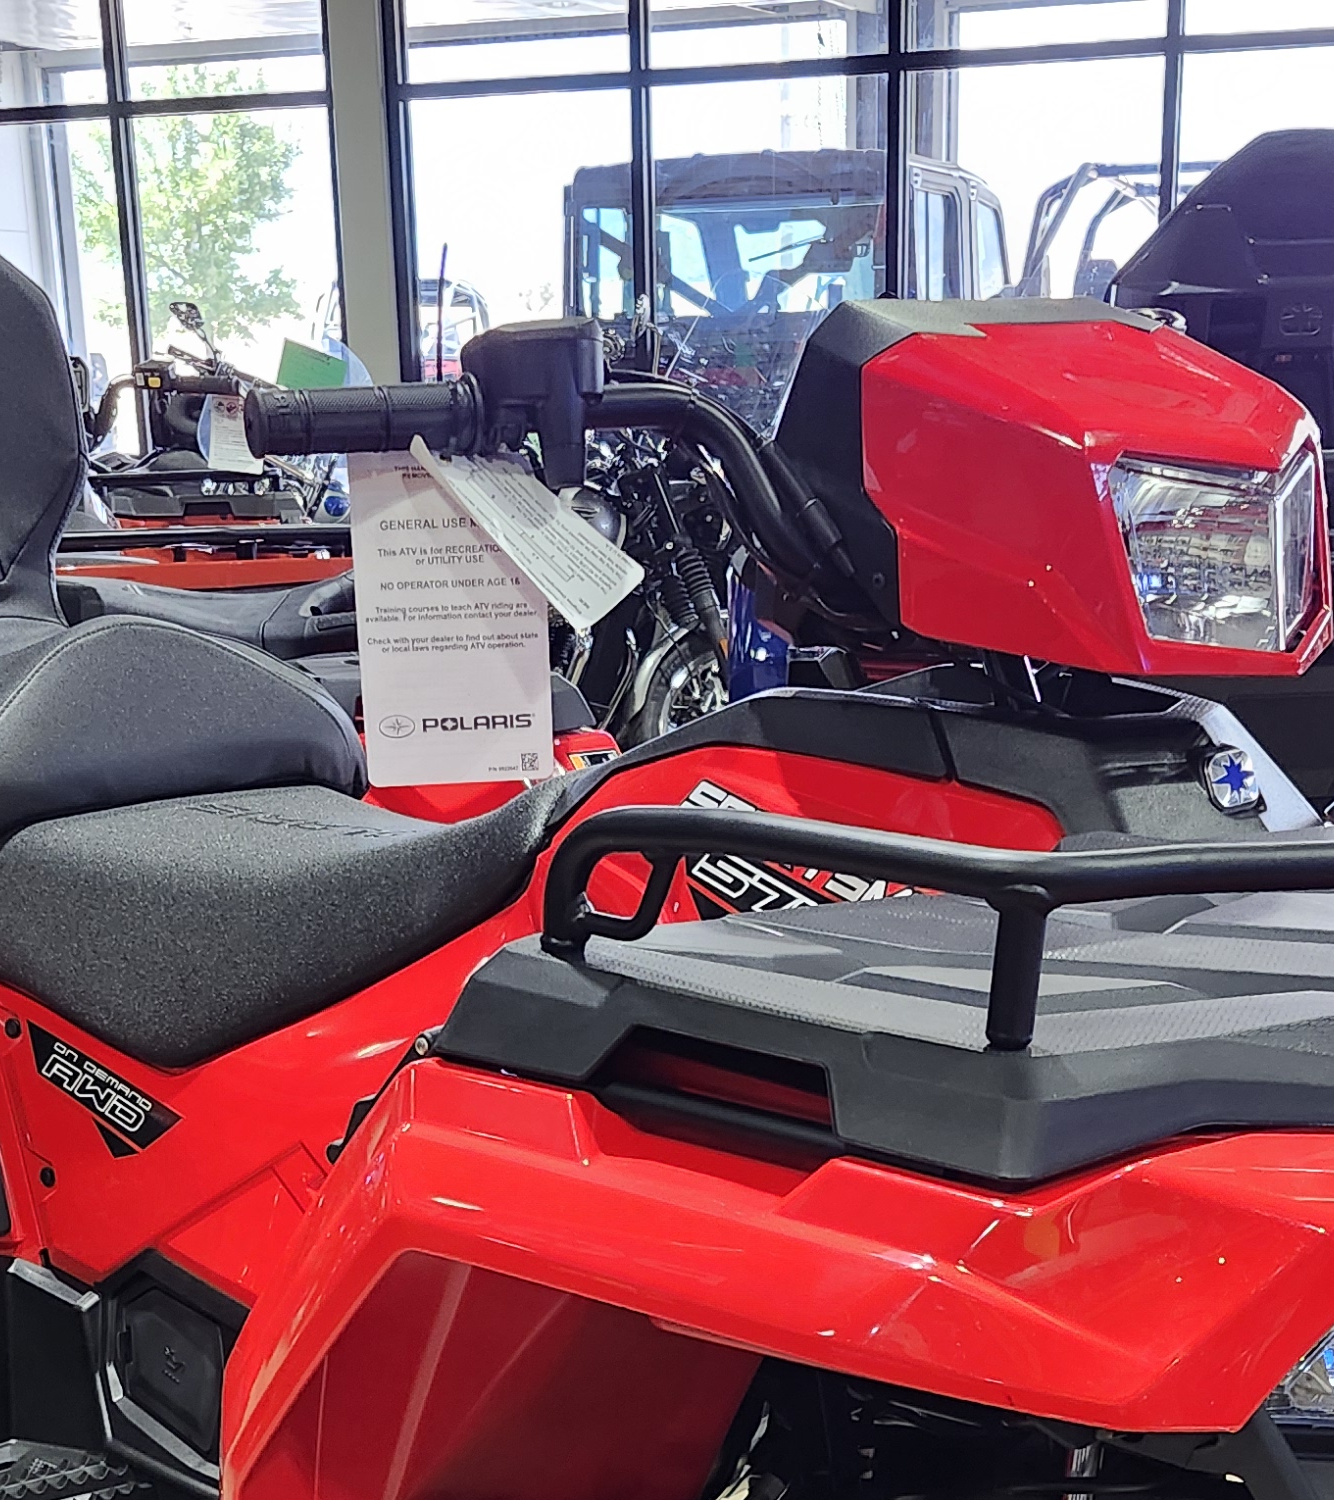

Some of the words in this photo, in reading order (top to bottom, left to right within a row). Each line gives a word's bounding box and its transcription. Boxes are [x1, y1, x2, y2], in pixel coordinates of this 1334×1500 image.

[380, 518, 438, 531] GENERAL
[442, 517, 466, 529] USE
[378, 548, 397, 557] This
[399, 547, 417, 556] ATV
[420, 547, 428, 555] is
[430, 546, 443, 555] for
[445, 544, 504, 554] RECREATIO
[415, 558, 426, 566] or
[428, 555, 463, 565] UTILITY
[465, 555, 485, 564] USE
[380, 582, 395, 591] NO
[396, 580, 449, 590] OPERATOR
[451, 578, 485, 588] UNDER
[487, 577, 507, 587] AGE
[510, 577, 521, 586] 16
[375, 606, 407, 616] Training
[408, 606, 439, 614] courses
[441, 604, 449, 612] to
[450, 603, 472, 612] teach
[474, 603, 490, 611] ATV
[491, 602, 514, 613] riding
[515, 602, 528, 610] are
[418, 612, 462, 622] information
[464, 611, 493, 620] contact
[494, 611, 512, 622] your
[367, 637, 392, 646] Check
[393, 636, 410, 645] with
[411, 637, 429, 646] your
[430, 635, 454, 644] dealer
[456, 635, 464, 643] to
[466, 633, 481, 642] find
[496, 632, 519, 640] about
[520, 631, 539, 640] state
[391, 644, 411, 653] local
[431, 644, 468, 654] regarding
[470, 642, 487, 650] ATV
[421, 713, 533, 733] POLARIS
[41, 1053, 146, 1132] AWD
[83, 1061, 153, 1112] DEMAND
